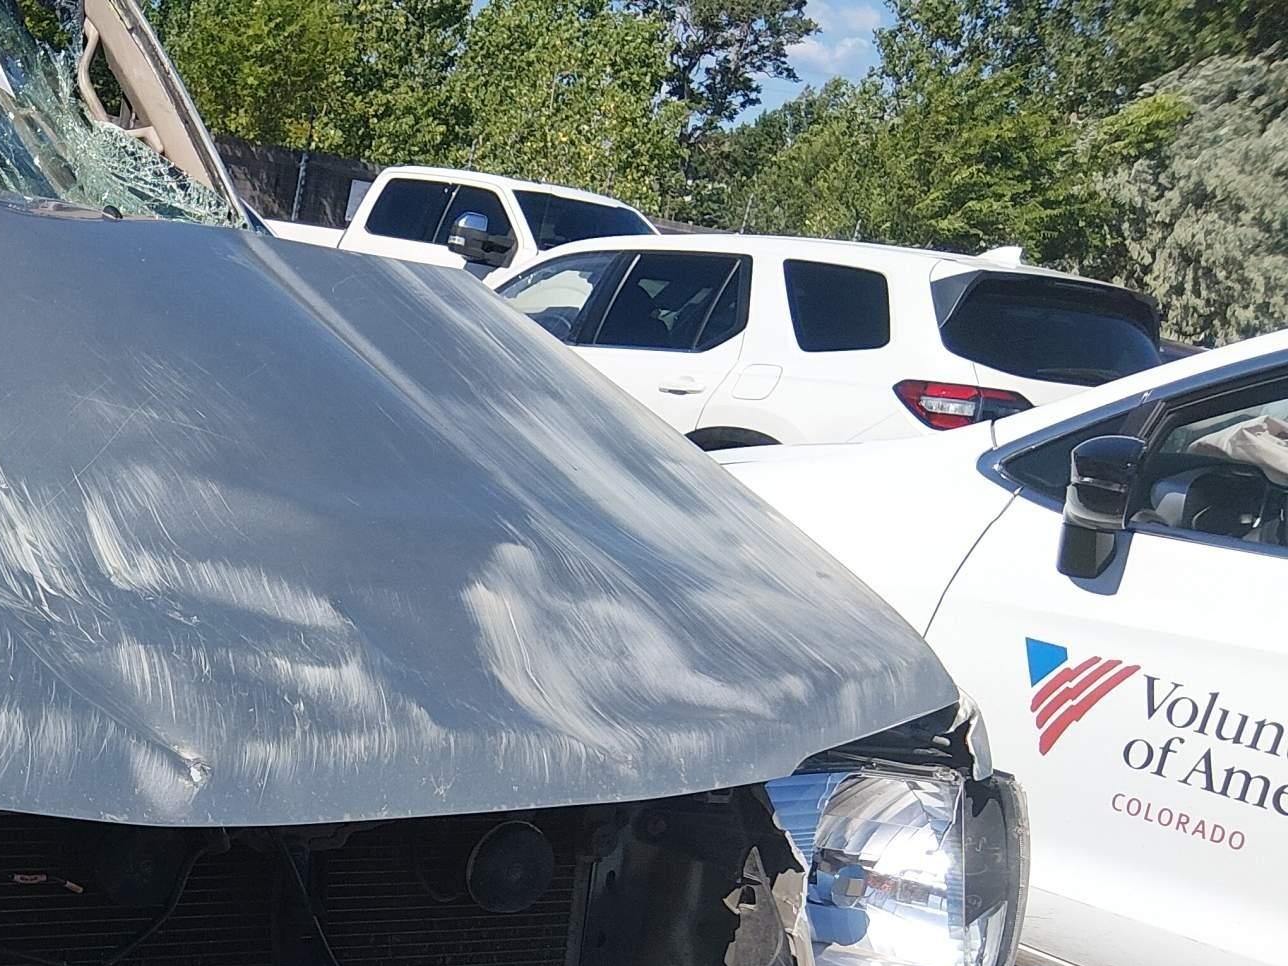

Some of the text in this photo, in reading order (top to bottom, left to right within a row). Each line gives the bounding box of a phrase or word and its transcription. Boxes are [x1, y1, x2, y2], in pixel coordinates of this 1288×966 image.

[1144, 674, 1288, 757] Volun
[1123, 736, 1185, 778] of
[1111, 793, 1245, 850] COLORADO
